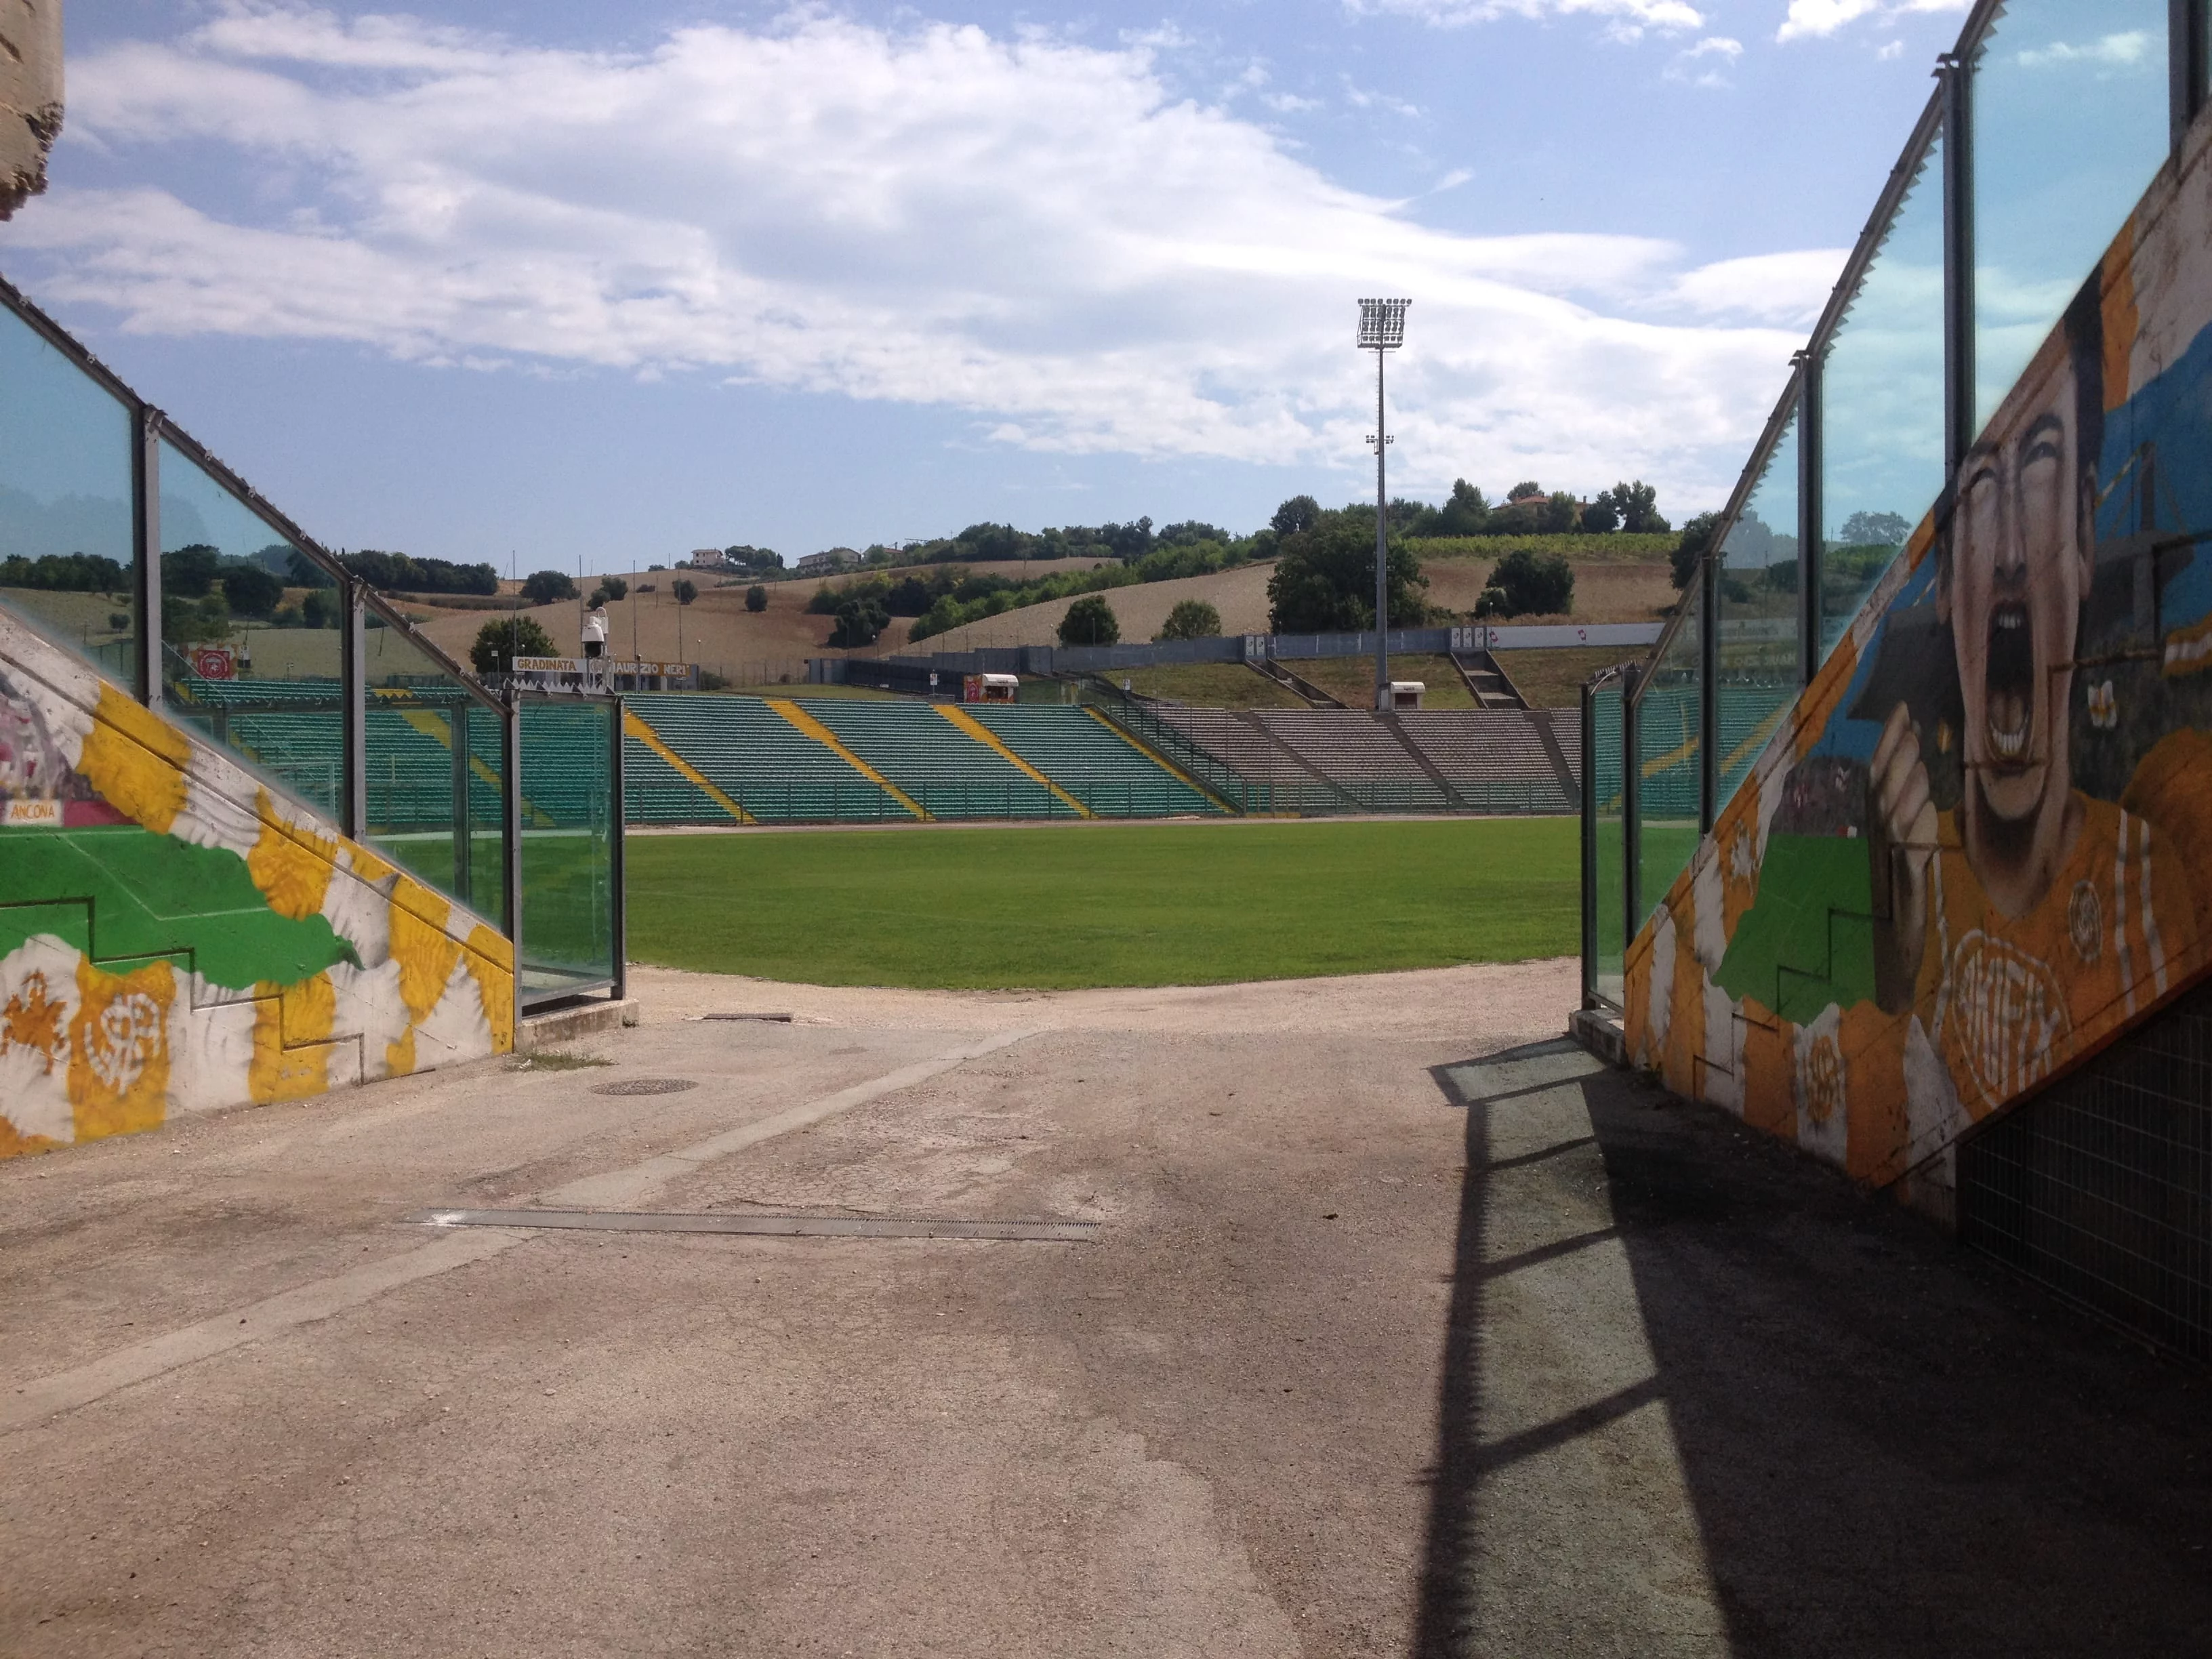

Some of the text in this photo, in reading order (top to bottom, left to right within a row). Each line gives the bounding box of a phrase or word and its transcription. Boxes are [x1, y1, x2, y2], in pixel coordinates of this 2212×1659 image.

[517, 659, 577, 671] GRADINATA
[609, 662, 659, 674] AURZIO
[10, 804, 55, 819] ANCONA
